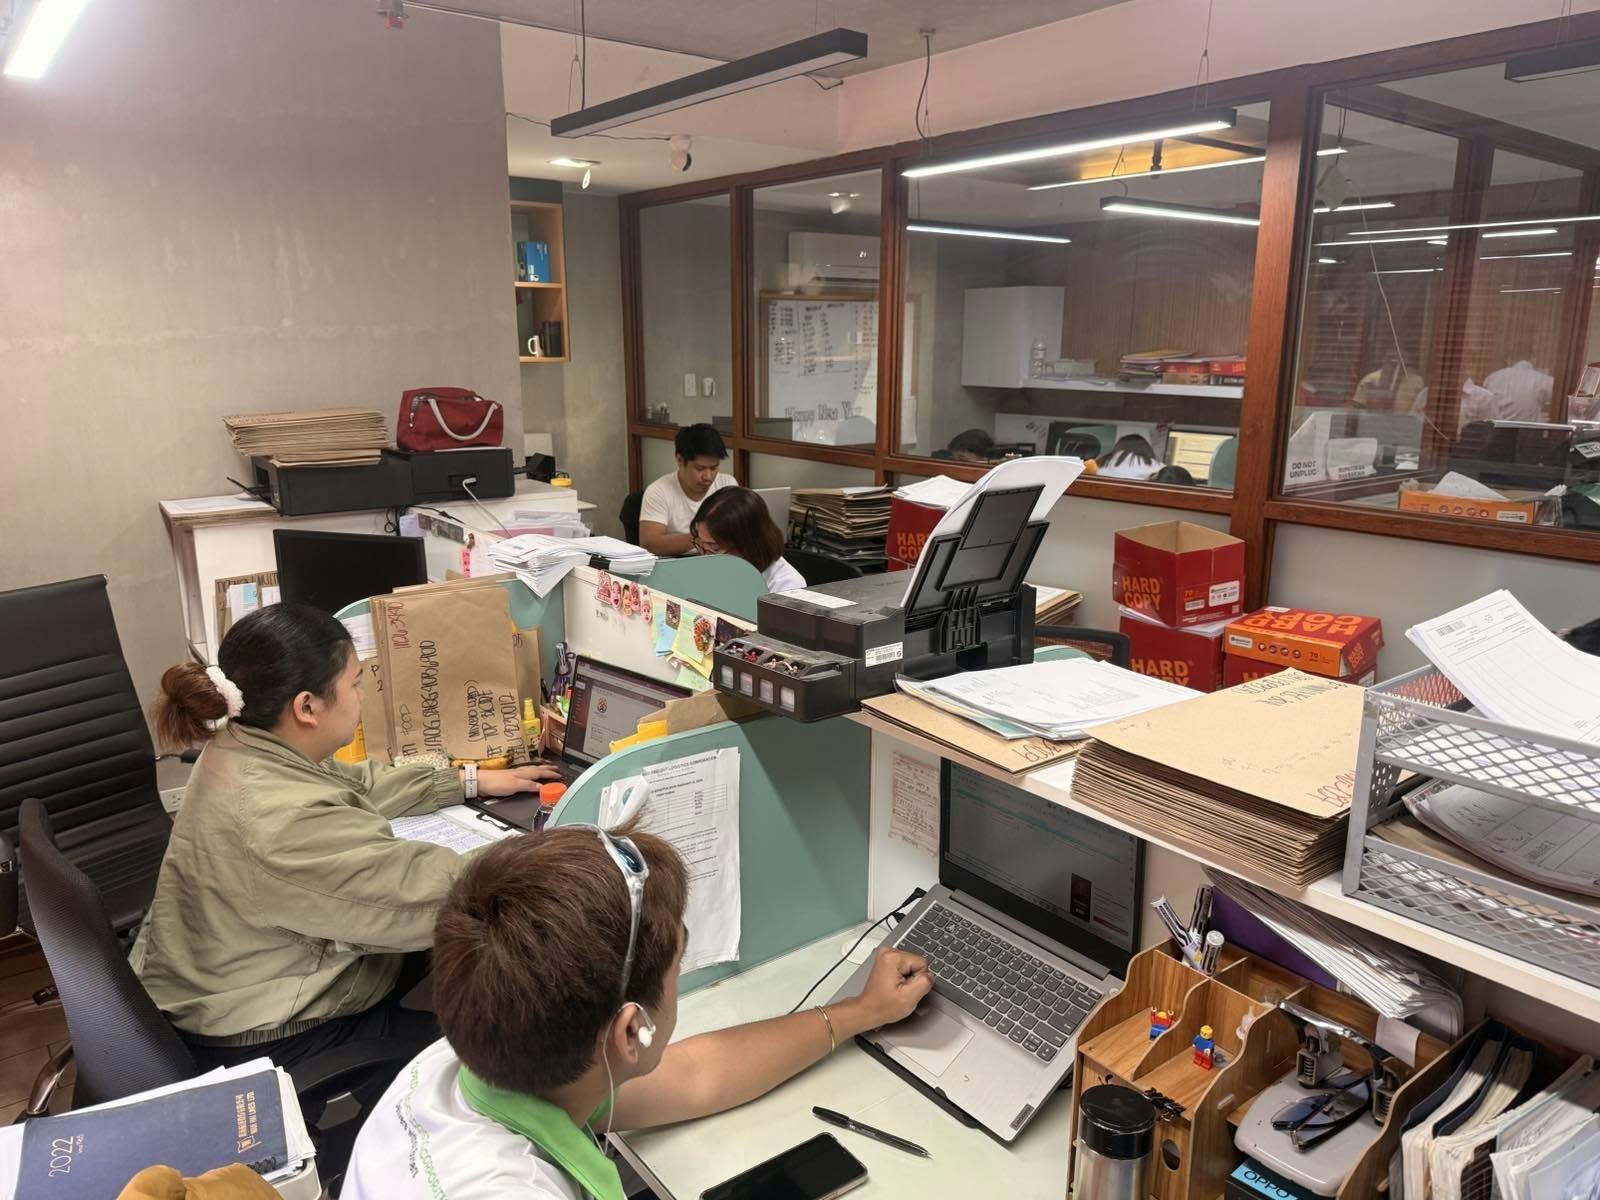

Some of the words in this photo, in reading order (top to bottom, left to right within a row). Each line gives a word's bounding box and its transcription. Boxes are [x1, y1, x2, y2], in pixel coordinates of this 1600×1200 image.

[1303, 460, 1317, 468] NOT
[1290, 469, 1318, 479] UNPLUG
[896, 532, 926, 546] HAR
[1121, 575, 1160, 594] HARD
[1124, 592, 1162, 611] COPY
[1244, 617, 1358, 636] HARD
[1254, 611, 1363, 626] COPY
[1130, 658, 1190, 677] HARD
[49, 1136, 74, 1177] 2022
[1243, 1169, 1291, 1199] OPPO
